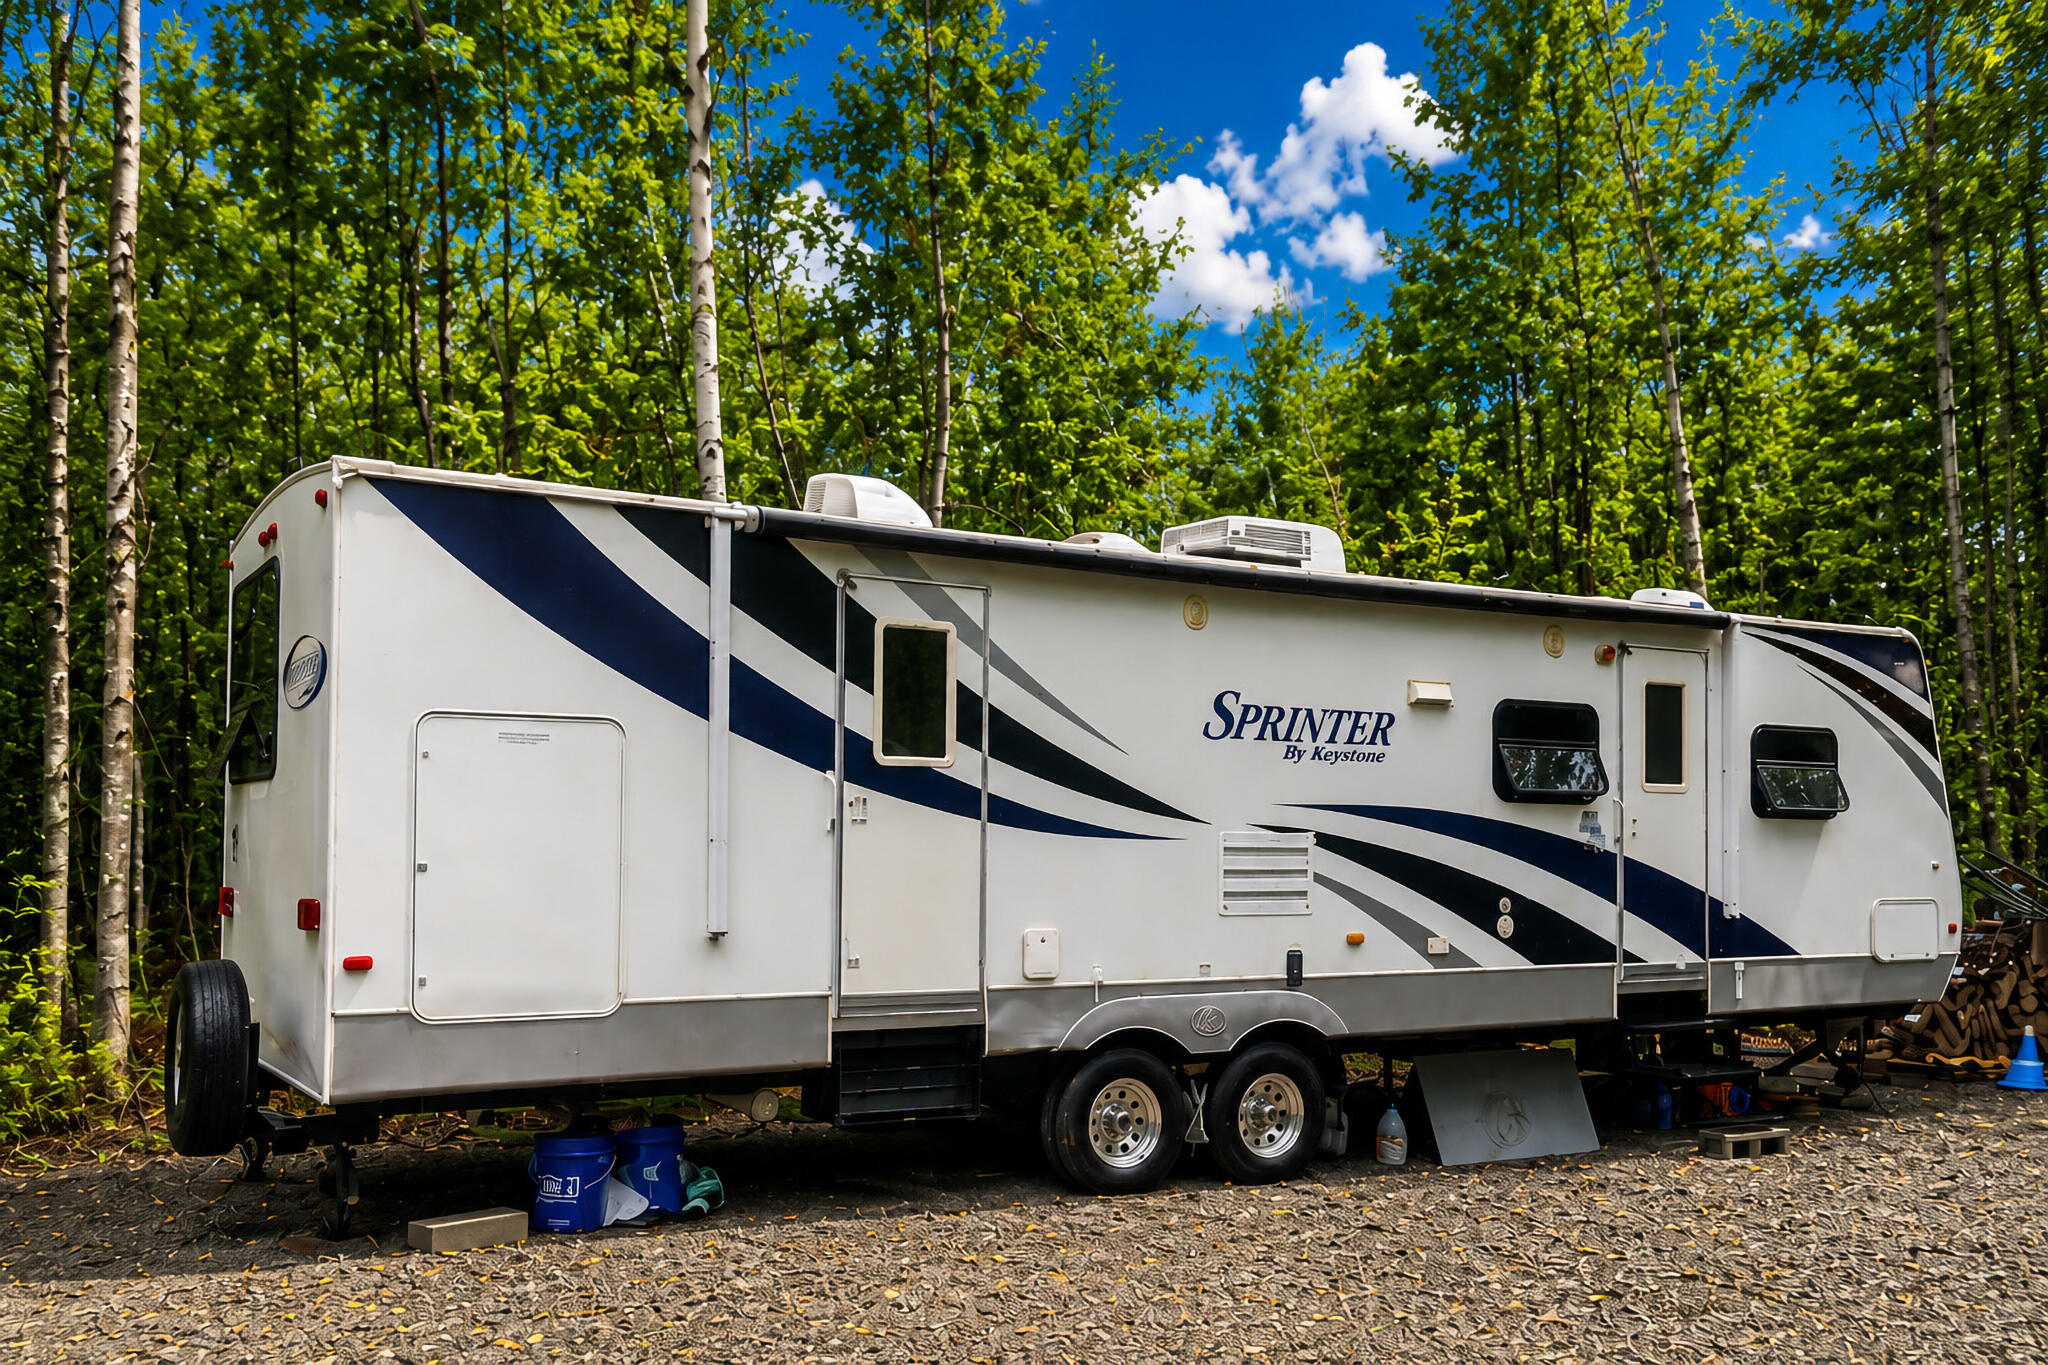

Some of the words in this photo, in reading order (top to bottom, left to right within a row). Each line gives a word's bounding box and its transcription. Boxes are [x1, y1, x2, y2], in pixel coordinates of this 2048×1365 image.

[1202, 690, 1396, 746] SPRINTER
[1283, 744, 1306, 764] By
[1310, 746, 1386, 765] Keystone
